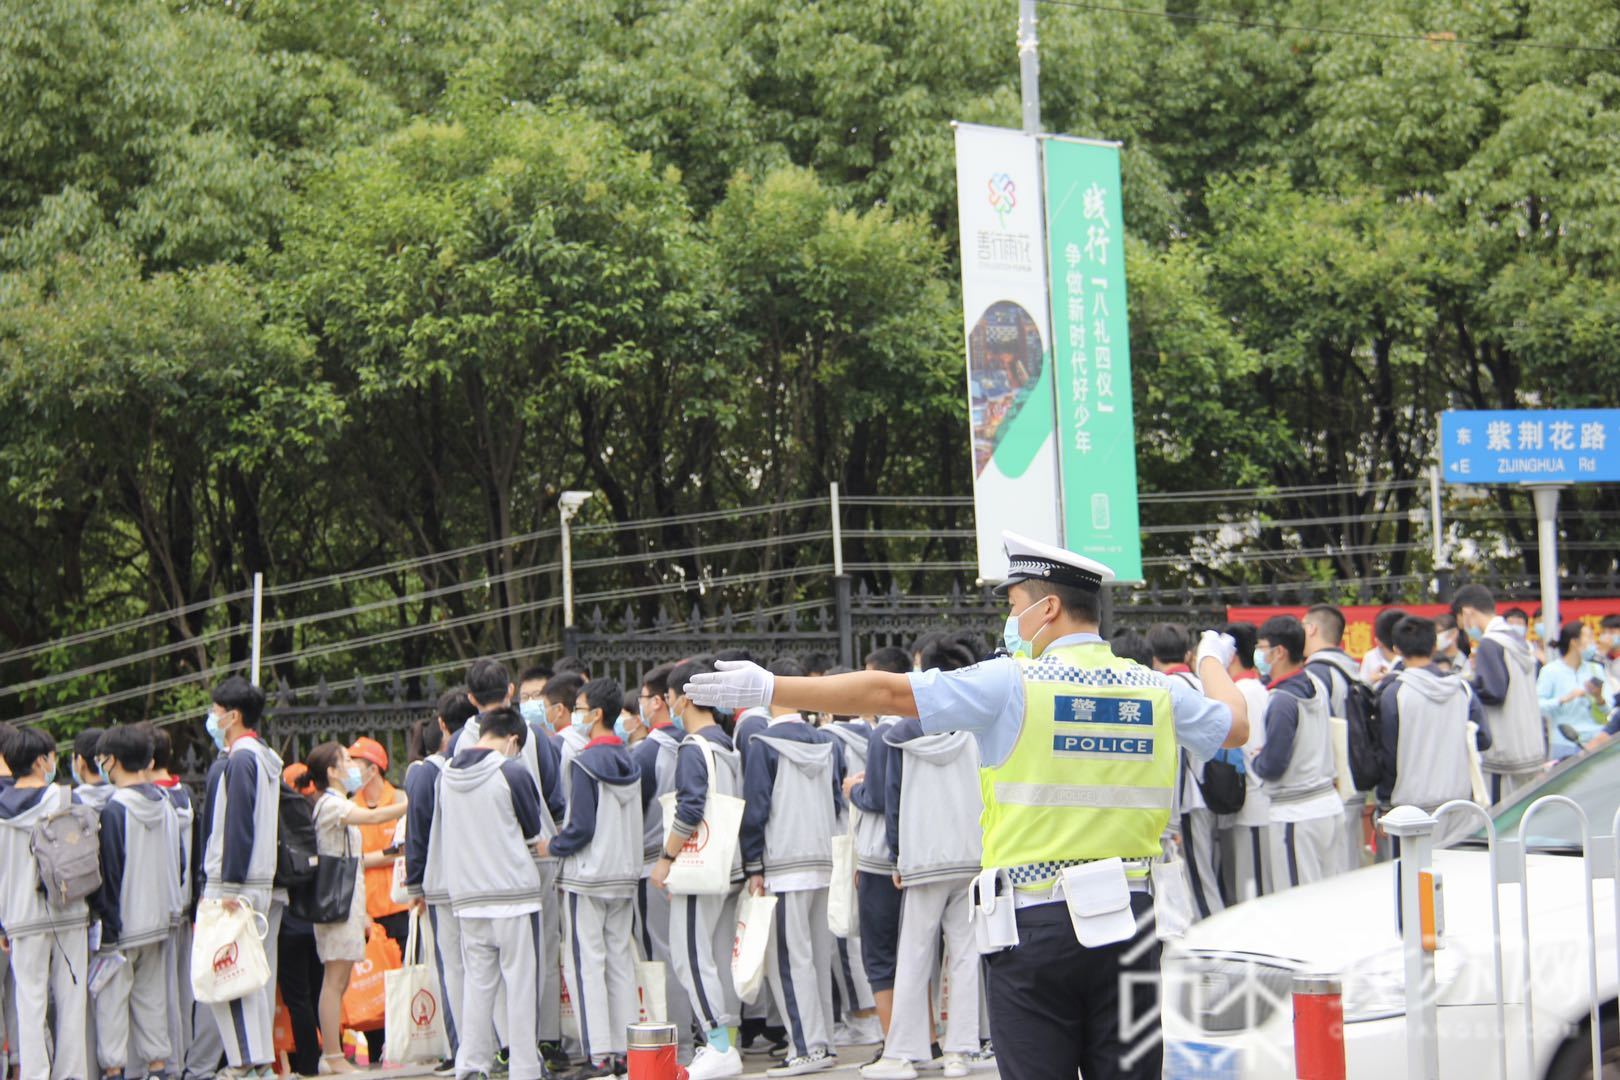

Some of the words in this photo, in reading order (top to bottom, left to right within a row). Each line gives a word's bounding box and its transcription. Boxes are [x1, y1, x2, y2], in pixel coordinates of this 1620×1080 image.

[1064, 242, 1092, 454] 争做新时代好少年
[1486, 421, 1607, 451] 紫荆花路
[1460, 459, 1471, 473] E
[1497, 458, 1565, 473] ZIJINGHUA
[1578, 457, 1596, 472] Rd
[1072, 698, 1142, 722] 警察
[1065, 737, 1147, 752] POLICE
